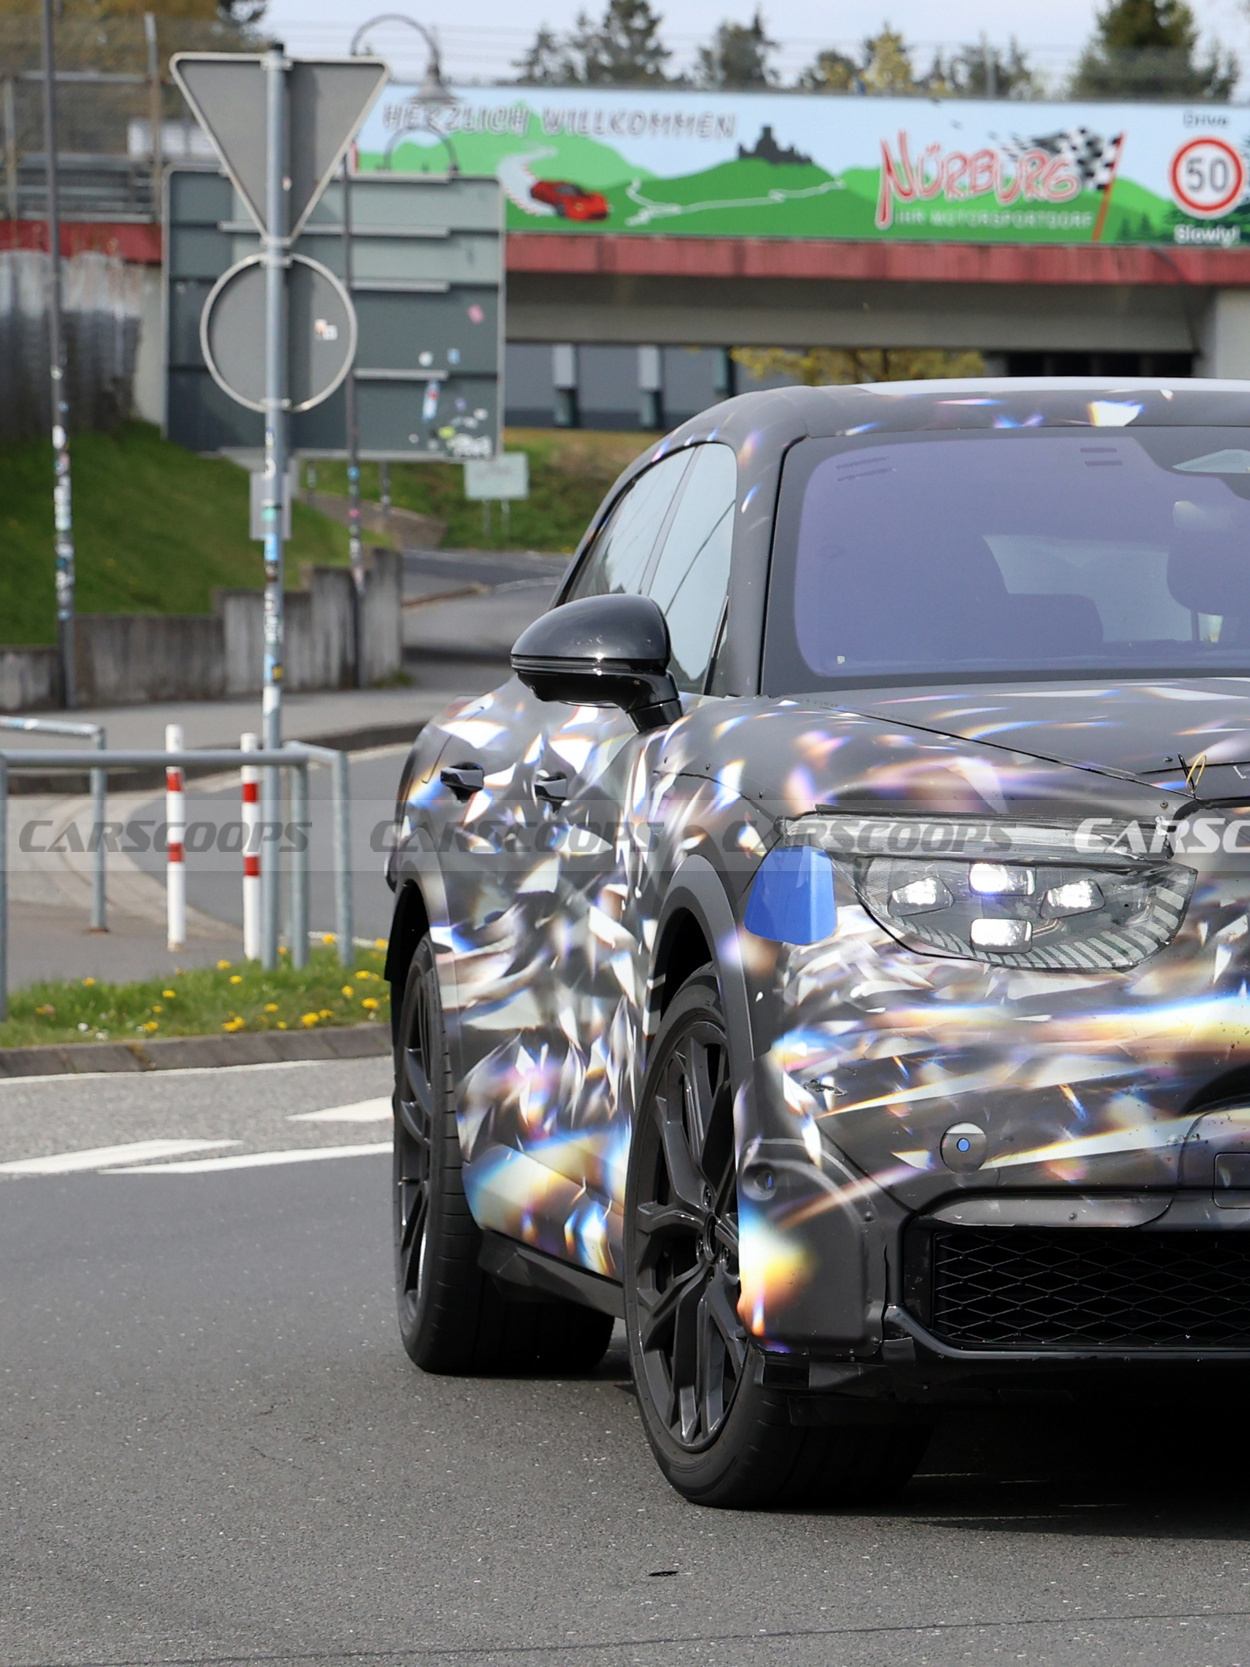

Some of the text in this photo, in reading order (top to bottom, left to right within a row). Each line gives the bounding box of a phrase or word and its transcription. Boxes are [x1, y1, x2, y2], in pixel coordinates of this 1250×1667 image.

[383, 101, 738, 140] HERZLICH WILLKOMMEN
[1183, 112, 1229, 128] Drive
[875, 128, 1082, 230] NÜRBURG
[1185, 156, 1230, 193] 50
